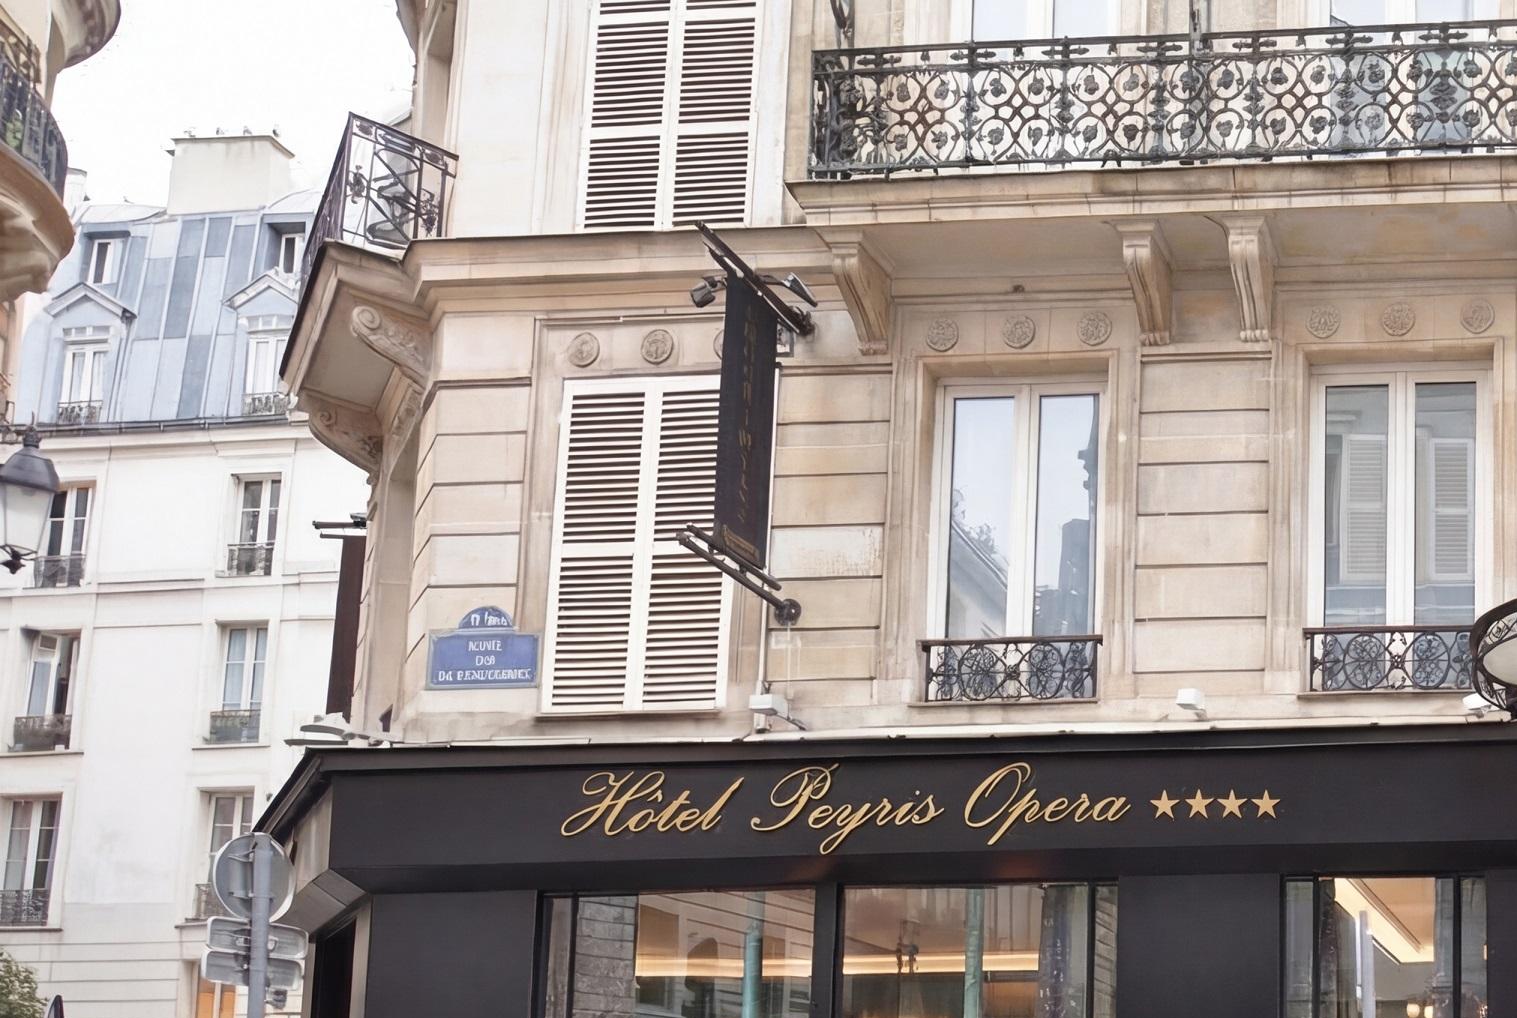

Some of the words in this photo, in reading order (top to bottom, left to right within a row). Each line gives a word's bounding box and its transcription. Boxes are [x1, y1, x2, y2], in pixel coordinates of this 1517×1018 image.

[560, 770, 745, 837] Hôtel
[751, 763, 945, 855] Peyris
[963, 762, 1132, 846] Opera
